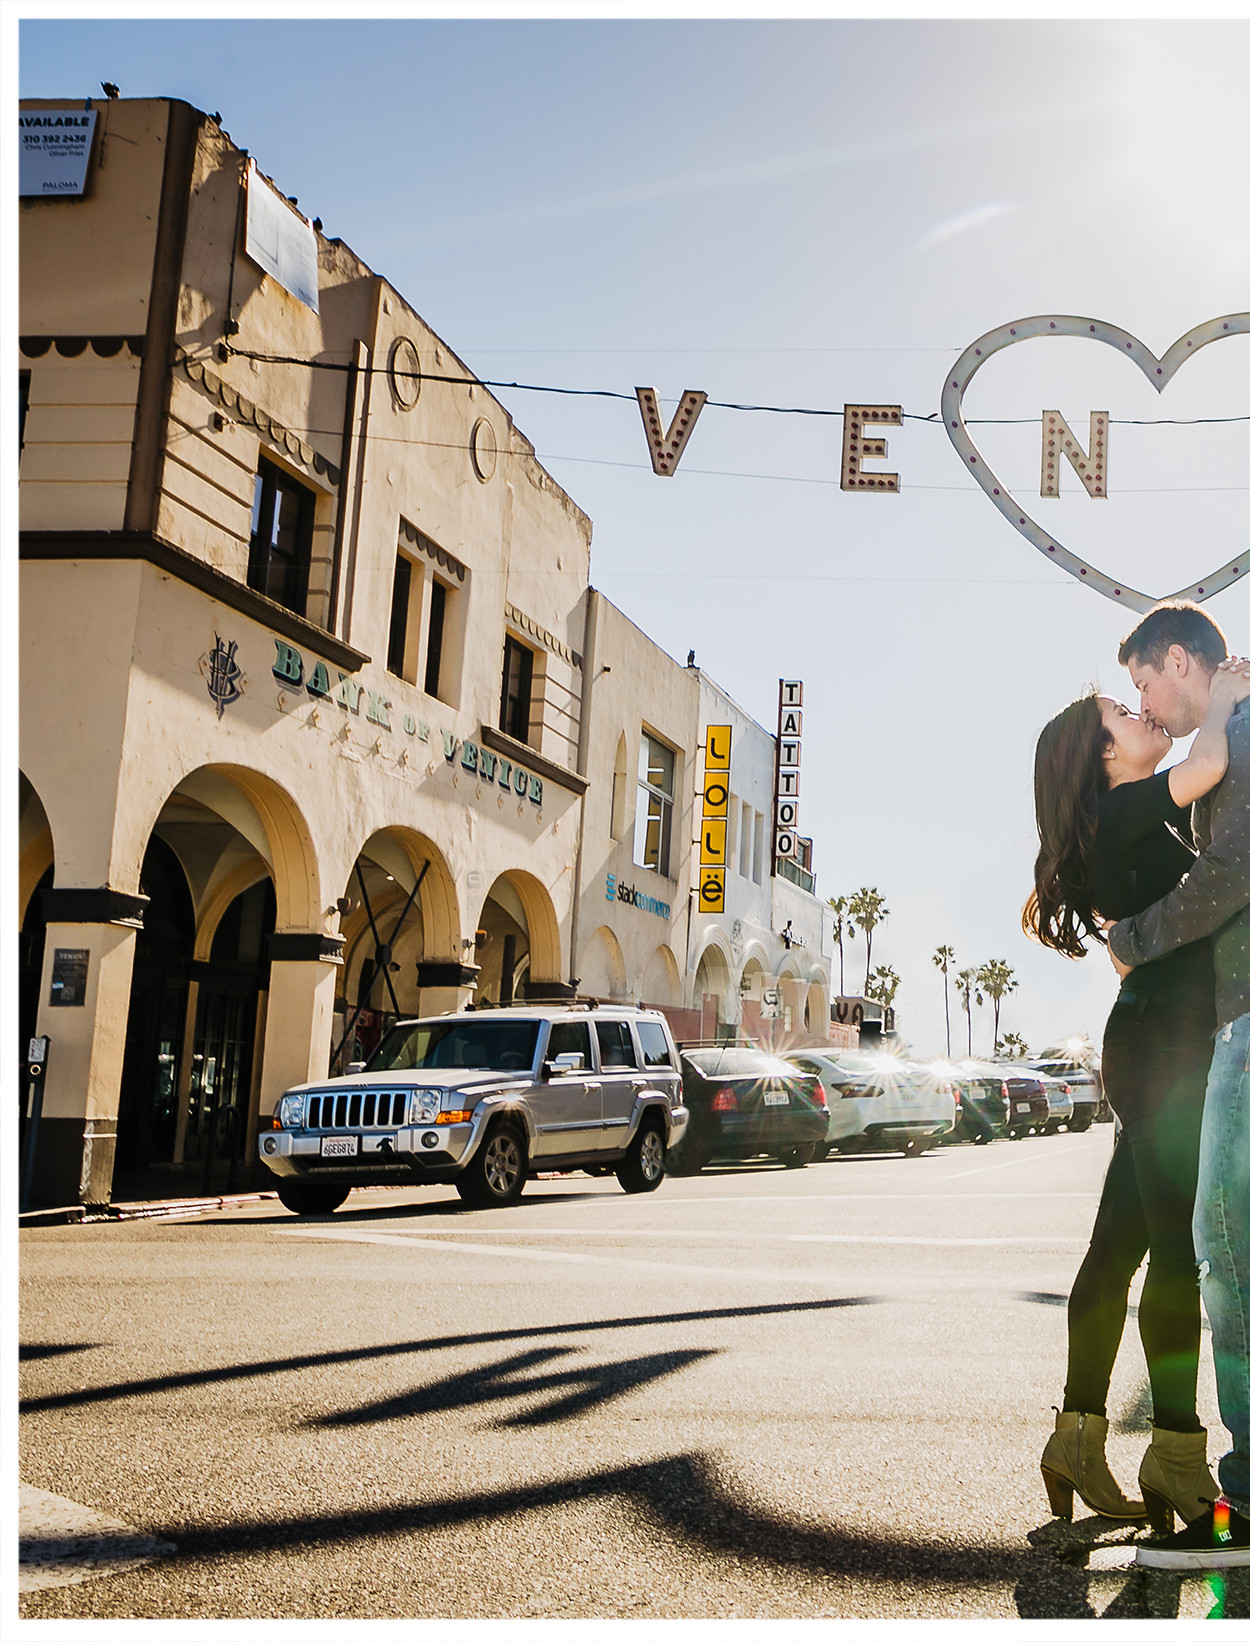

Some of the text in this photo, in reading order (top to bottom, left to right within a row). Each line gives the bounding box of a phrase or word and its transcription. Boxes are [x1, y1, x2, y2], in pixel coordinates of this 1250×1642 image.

[18, 116, 90, 127] AVAILABLE
[23, 134, 87, 143] 310 392 2436
[42, 181, 79, 189] PALOMA
[272, 639, 545, 806] BANK OF VENICE
[778, 683, 799, 854] TATTOO
